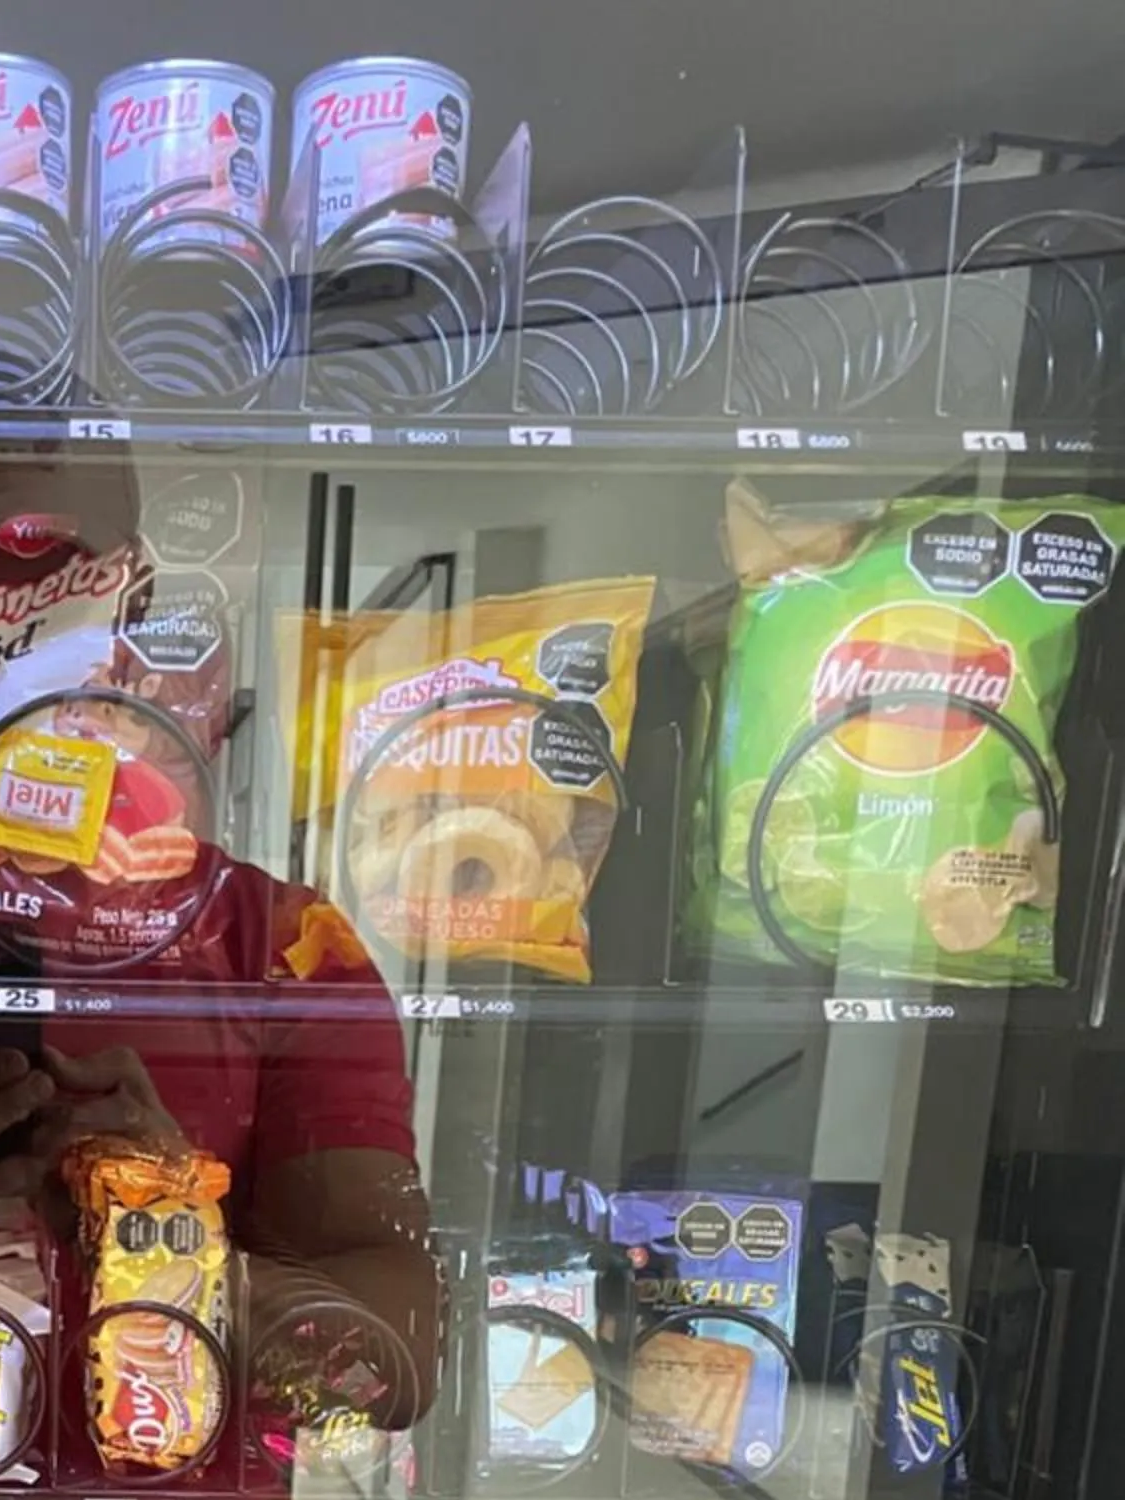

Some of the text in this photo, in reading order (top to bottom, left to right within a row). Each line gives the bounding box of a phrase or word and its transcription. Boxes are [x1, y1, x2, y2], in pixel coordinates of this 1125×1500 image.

[106, 82, 200, 160] Zenú
[311, 80, 406, 150] Zenú
[817, 658, 1007, 713] Margarita
[6, 779, 74, 817] Miel
[857, 793, 933, 817] Limón
[5, 990, 41, 1008] 25
[65, 998, 112, 1011] $1,400
[411, 998, 443, 1016] 27
[463, 1001, 515, 1016] $1,400
[833, 1001, 869, 1020] 29
[119, 1366, 170, 1450] Dux
[898, 1355, 952, 1448] Jet
